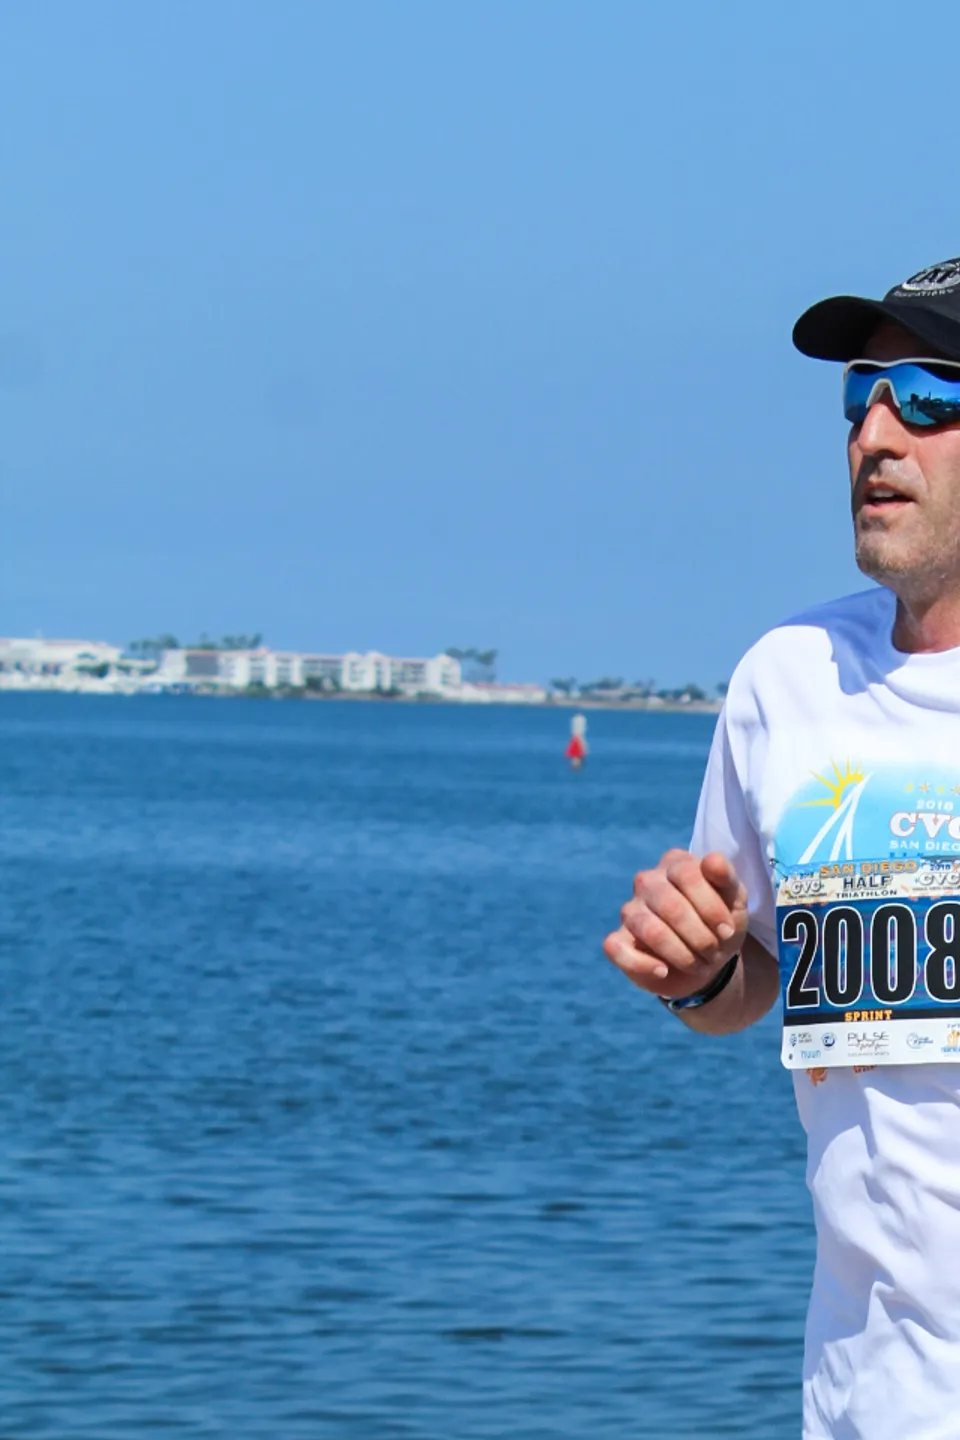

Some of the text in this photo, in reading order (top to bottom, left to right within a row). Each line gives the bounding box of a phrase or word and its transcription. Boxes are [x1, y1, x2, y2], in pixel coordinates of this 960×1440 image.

[889, 840, 920, 850] SAN
[820, 863, 855, 877] SAN
[861, 860, 918, 874] DIEGO
[843, 875, 892, 889] HALF
[919, 872, 960, 886] CVC
[791, 880, 821, 895] CVC
[836, 889, 897, 899] TRIATHLON
[844, 1009, 893, 1022] SPRINT
